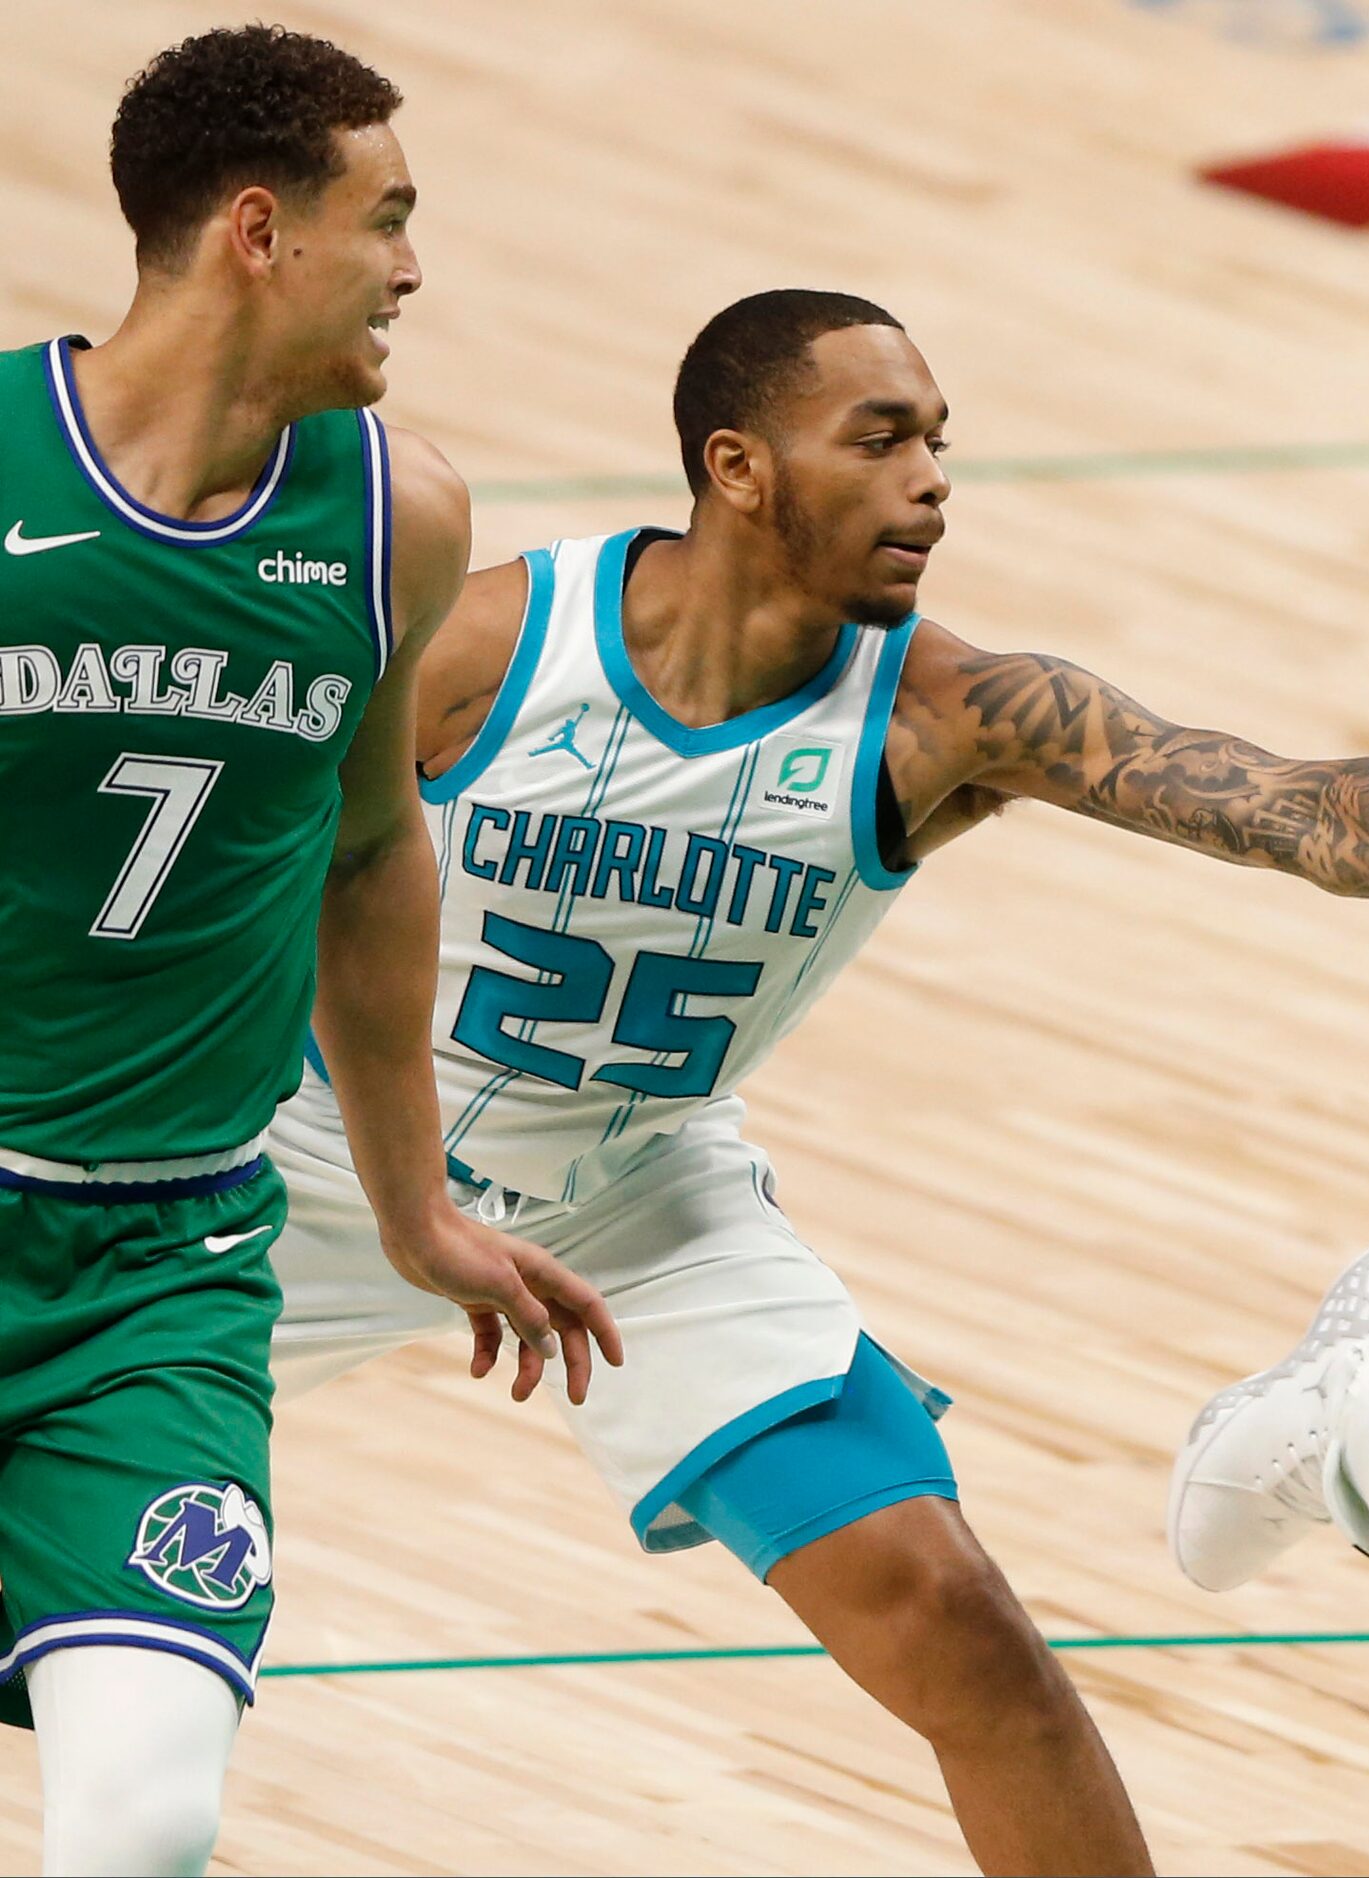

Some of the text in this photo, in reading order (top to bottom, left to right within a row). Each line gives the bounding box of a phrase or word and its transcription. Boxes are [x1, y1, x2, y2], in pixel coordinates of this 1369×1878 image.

[257, 550, 347, 586] chime
[0, 643, 352, 742] DALLAS
[88, 751, 226, 940] 7
[763, 789, 829, 812] lendingtree
[461, 802, 837, 939] CHARLOTTE
[450, 911, 765, 1099] 25
